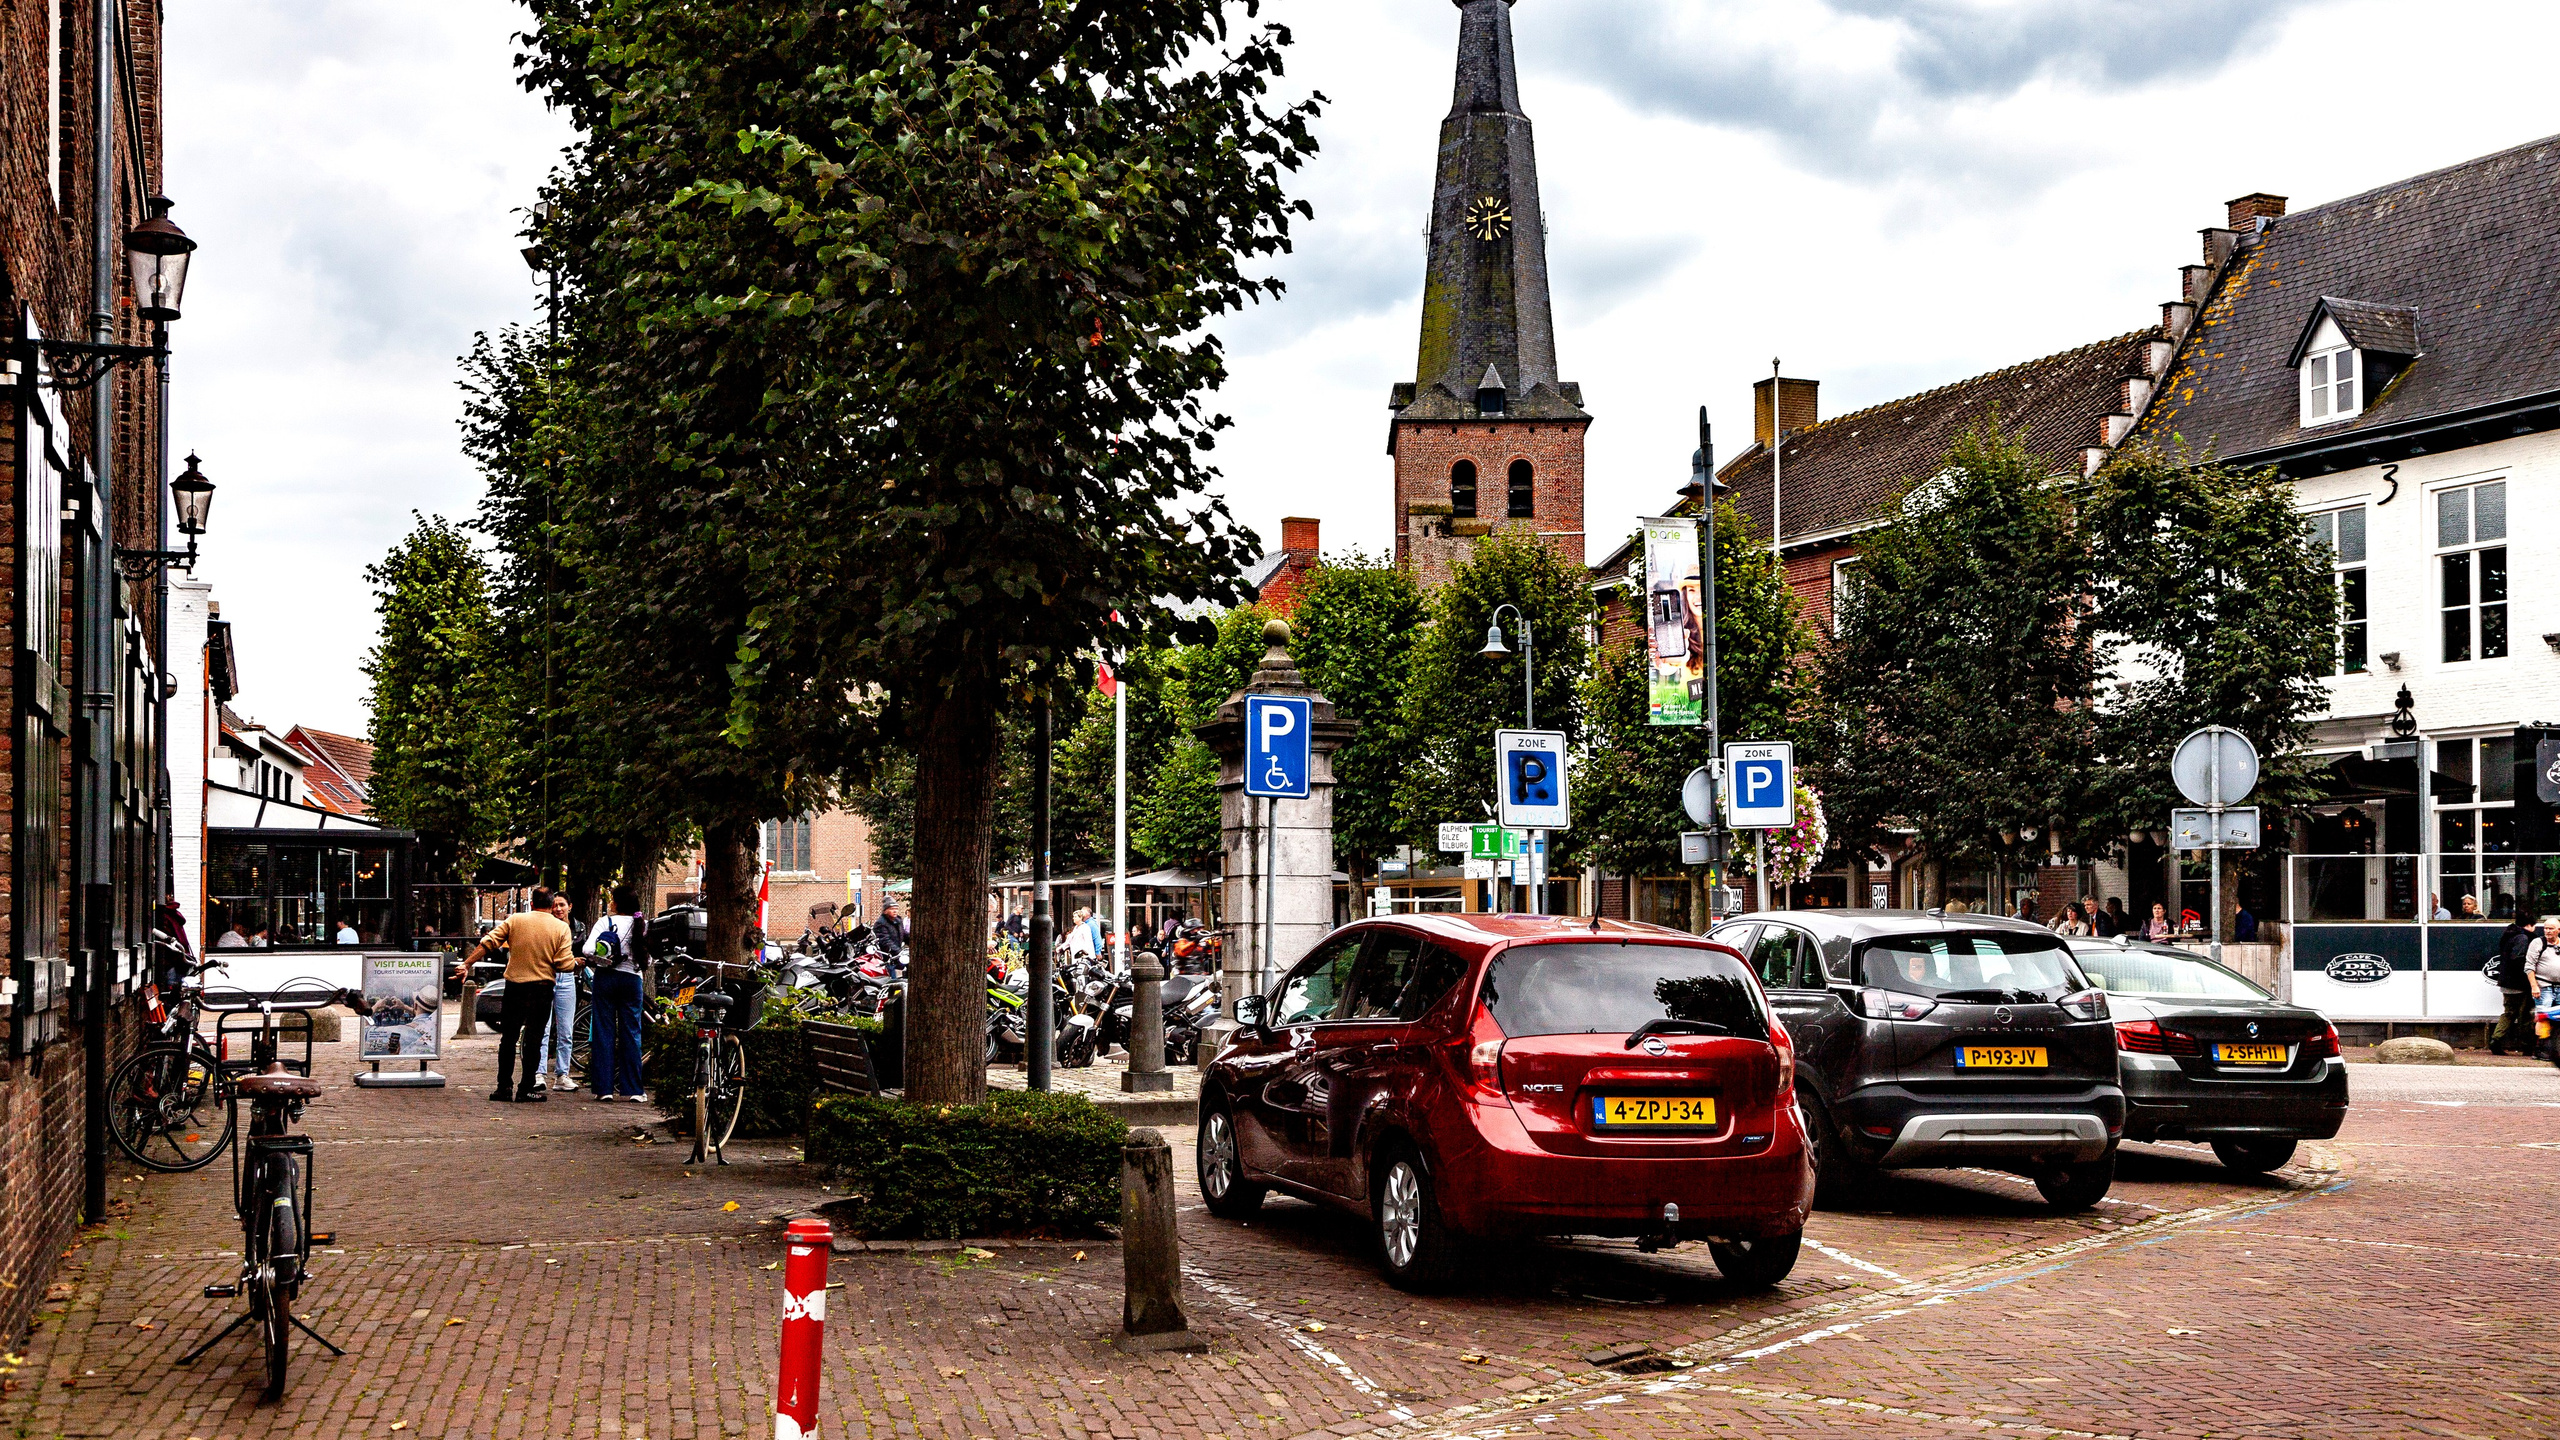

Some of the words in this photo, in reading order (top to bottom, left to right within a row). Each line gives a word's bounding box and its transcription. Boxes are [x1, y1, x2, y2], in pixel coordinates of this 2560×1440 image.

[1691, 683, 1703, 696] NL
[1261, 705, 1296, 753] P
[1517, 738, 1547, 749] ZONE
[1744, 749, 1773, 758] ZONE
[1519, 755, 1547, 797] P
[1746, 766, 1773, 803] P
[1873, 886, 1886, 897] DM
[374, 960, 396, 968] VISIT
[397, 960, 432, 968] BAARLE
[2329, 969, 2390, 977] POMP
[1971, 1049, 2037, 1065] P-193-JV
[2225, 1045, 2278, 1060] 2-SFH-11
[1522, 1083, 1564, 1092] NOTE
[1595, 1112, 1605, 1120] NL
[1614, 1100, 1704, 1120] 4-ZPJ-34
